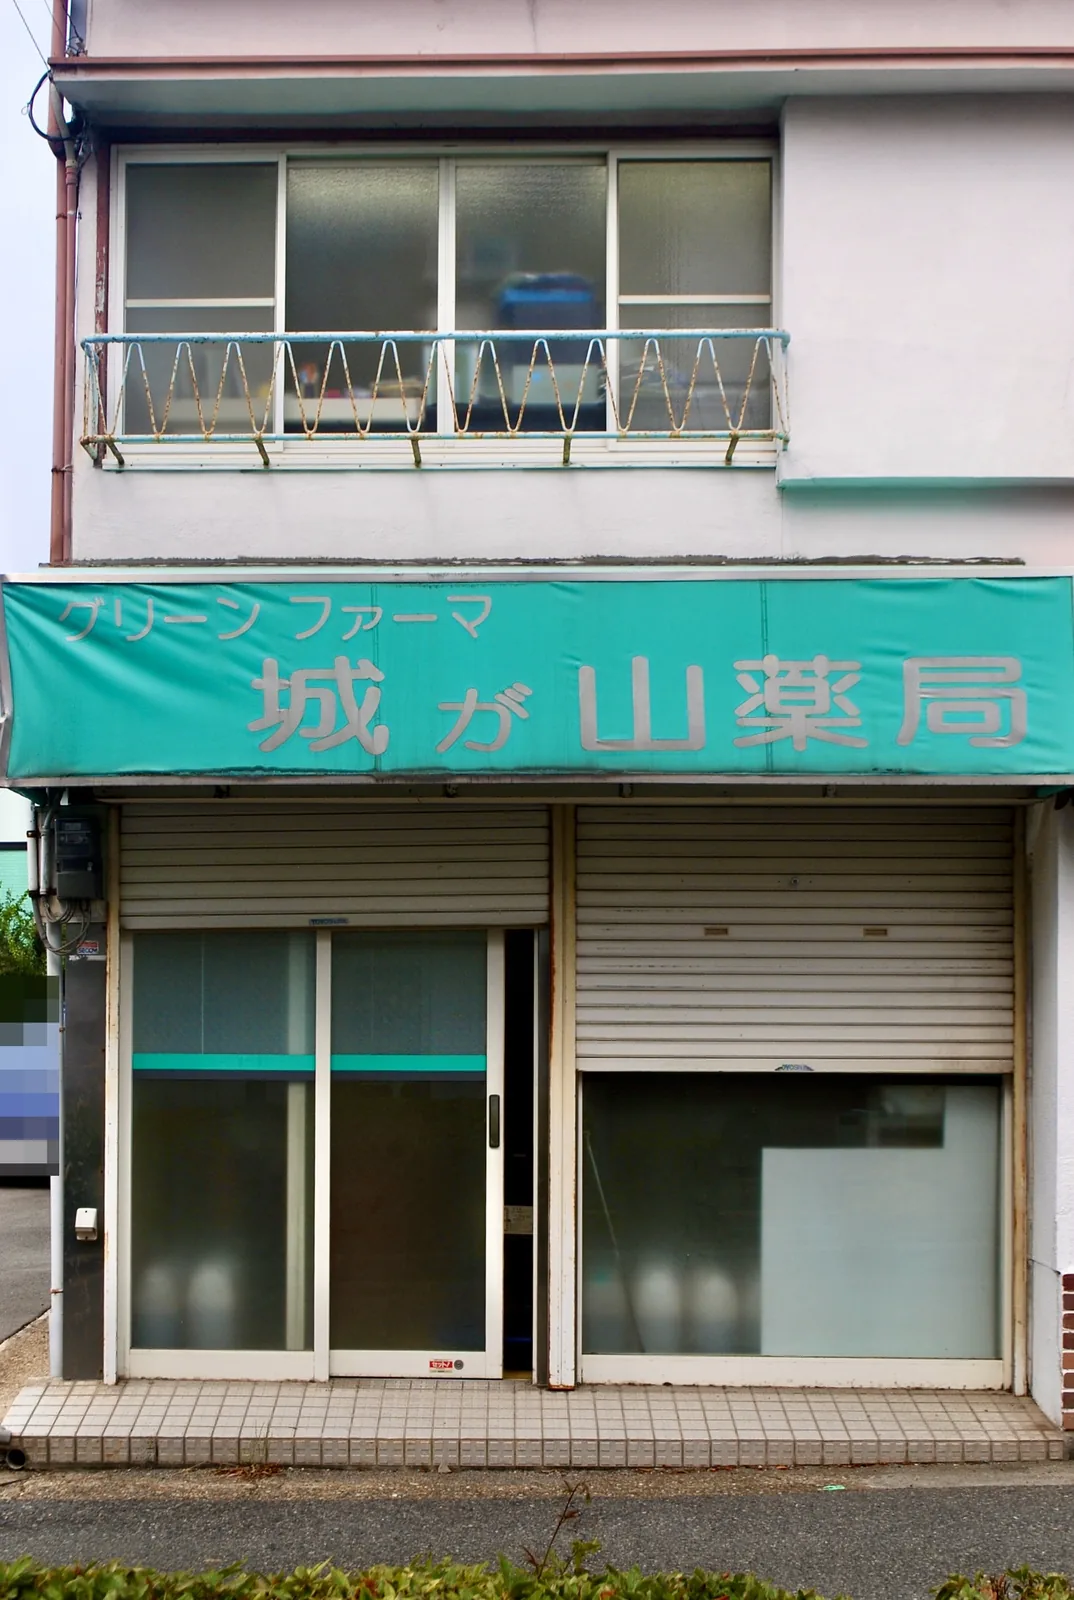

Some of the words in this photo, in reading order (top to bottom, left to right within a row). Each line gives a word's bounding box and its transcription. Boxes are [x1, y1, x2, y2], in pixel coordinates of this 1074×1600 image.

[246, 654, 1028, 756] 城が山薬局
